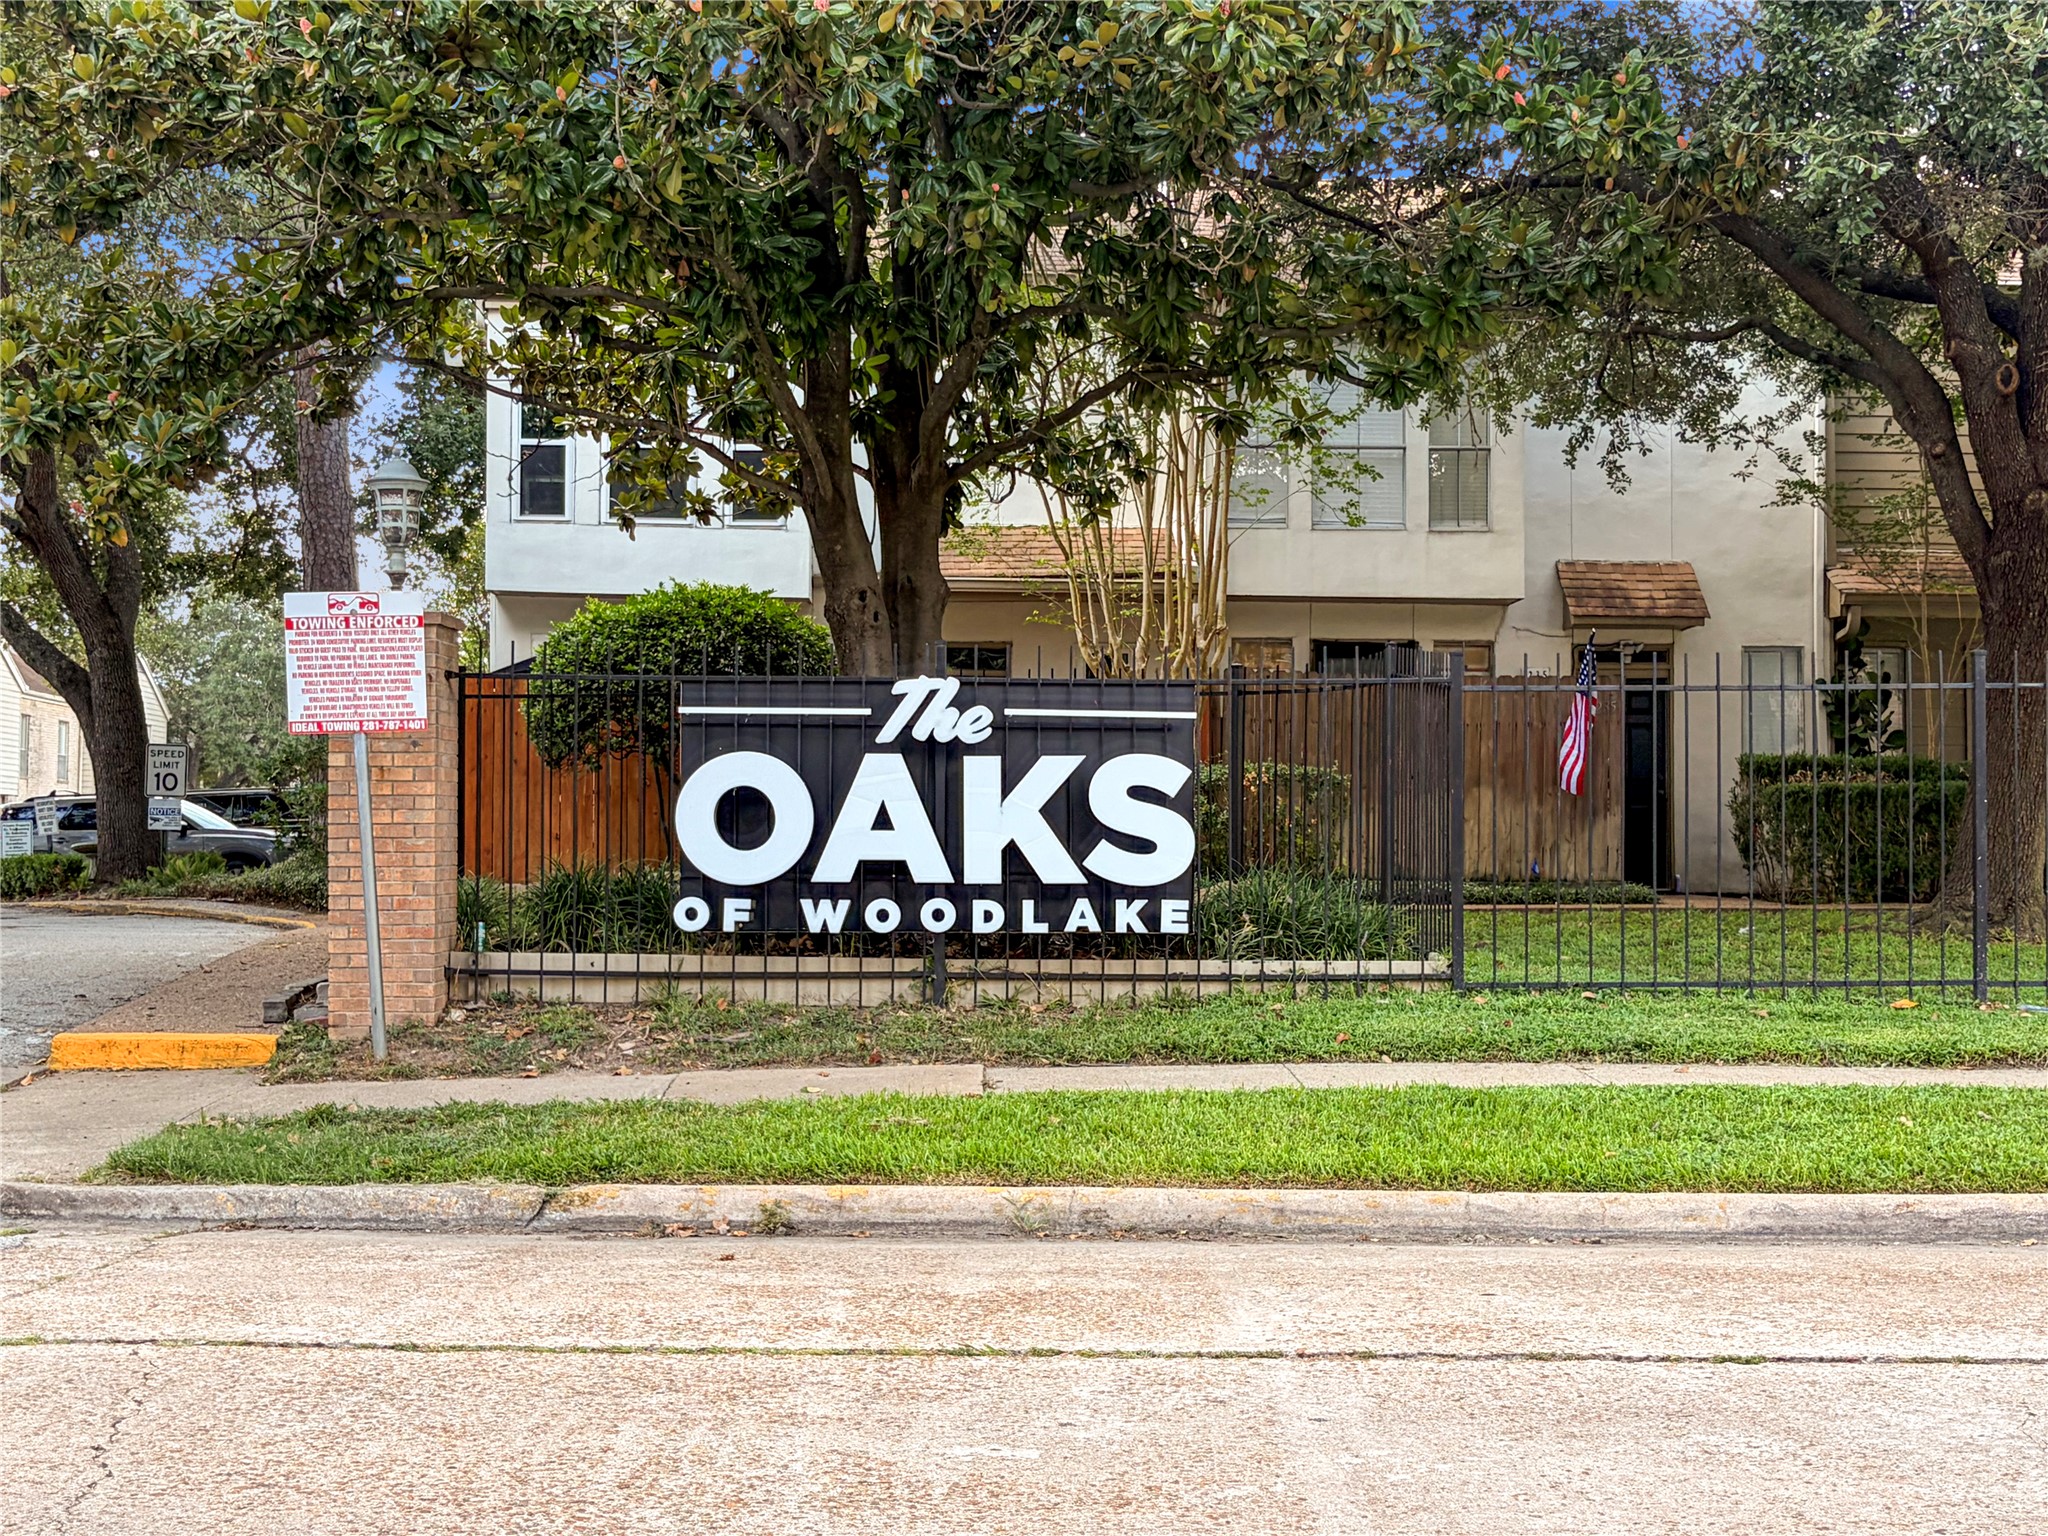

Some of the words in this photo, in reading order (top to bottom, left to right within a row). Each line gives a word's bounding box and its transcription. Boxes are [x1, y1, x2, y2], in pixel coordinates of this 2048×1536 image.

[291, 617, 346, 630] TOWING
[349, 616, 419, 629] ENFORCED
[875, 675, 994, 744] The
[292, 722, 320, 732] IDEAL
[321, 721, 360, 732] TOWING
[362, 720, 426, 731] 281-787-1401
[150, 749, 185, 758] SPEED
[153, 761, 180, 770] LIMIT
[154, 772, 178, 792] 10
[150, 808, 180, 816] NOTICE
[674, 750, 1197, 886] OAKS
[672, 896, 755, 933] OF
[799, 897, 1191, 935] WOODLAKE
